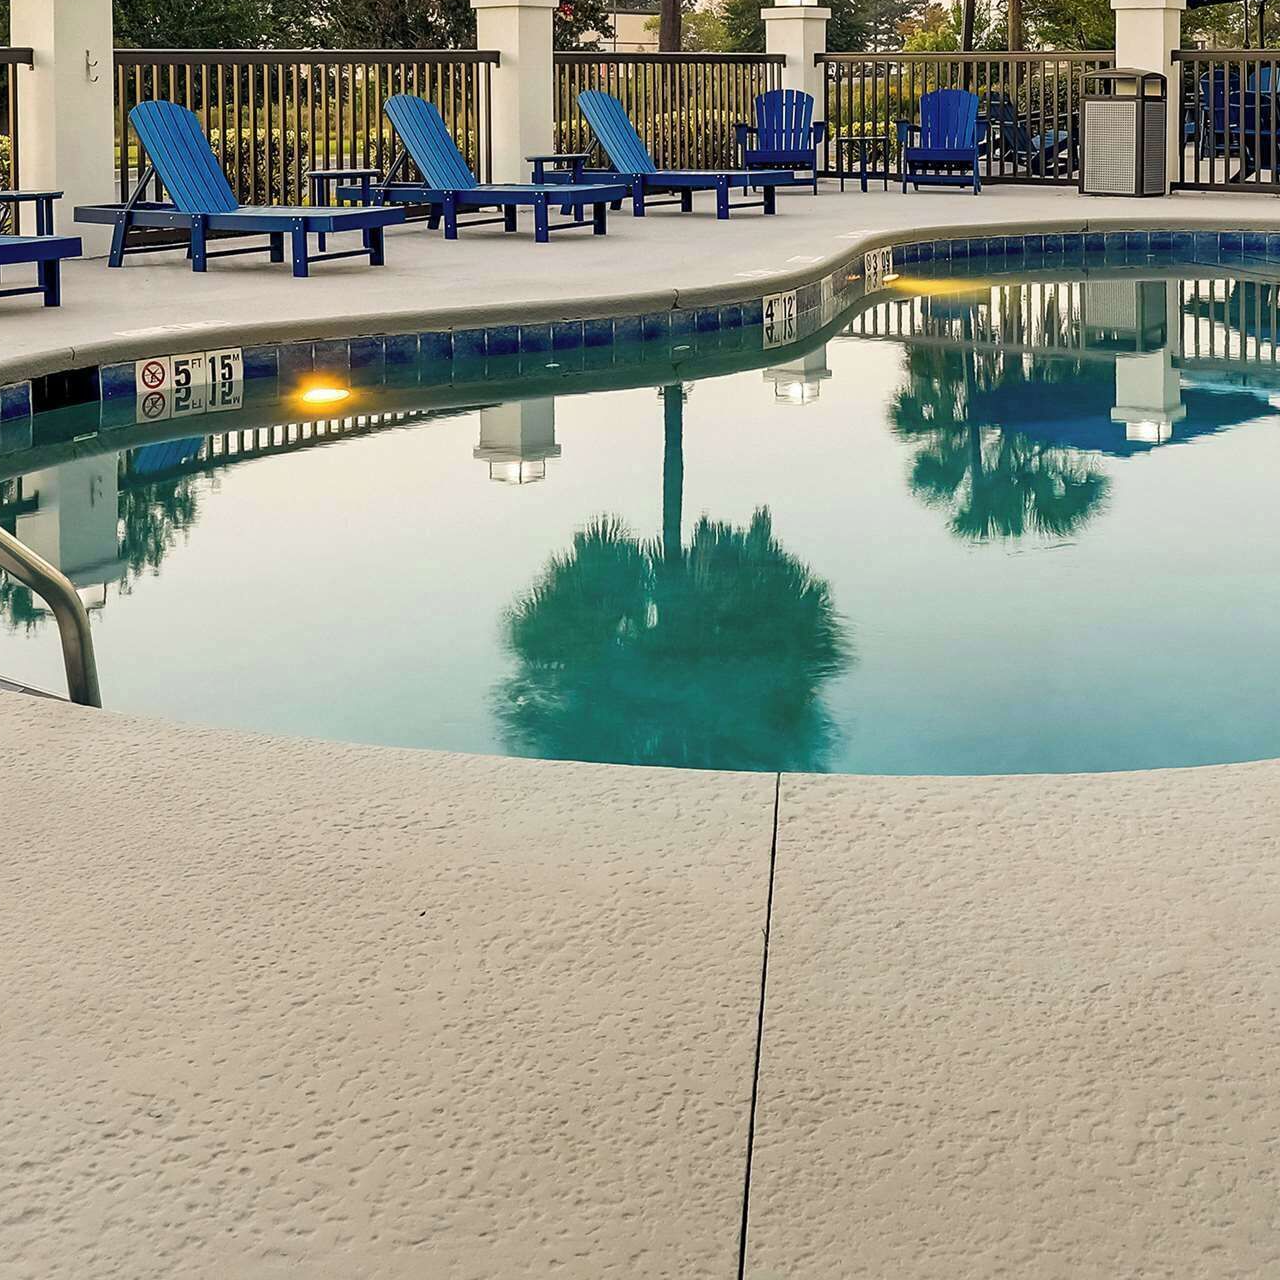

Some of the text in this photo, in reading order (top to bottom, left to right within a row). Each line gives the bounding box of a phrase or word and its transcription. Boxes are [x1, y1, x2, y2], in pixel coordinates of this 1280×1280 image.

[765, 299, 775, 322] 4
[174, 360, 192, 387] 5
[191, 357, 202, 369] FT
[232, 353, 240, 362] M
